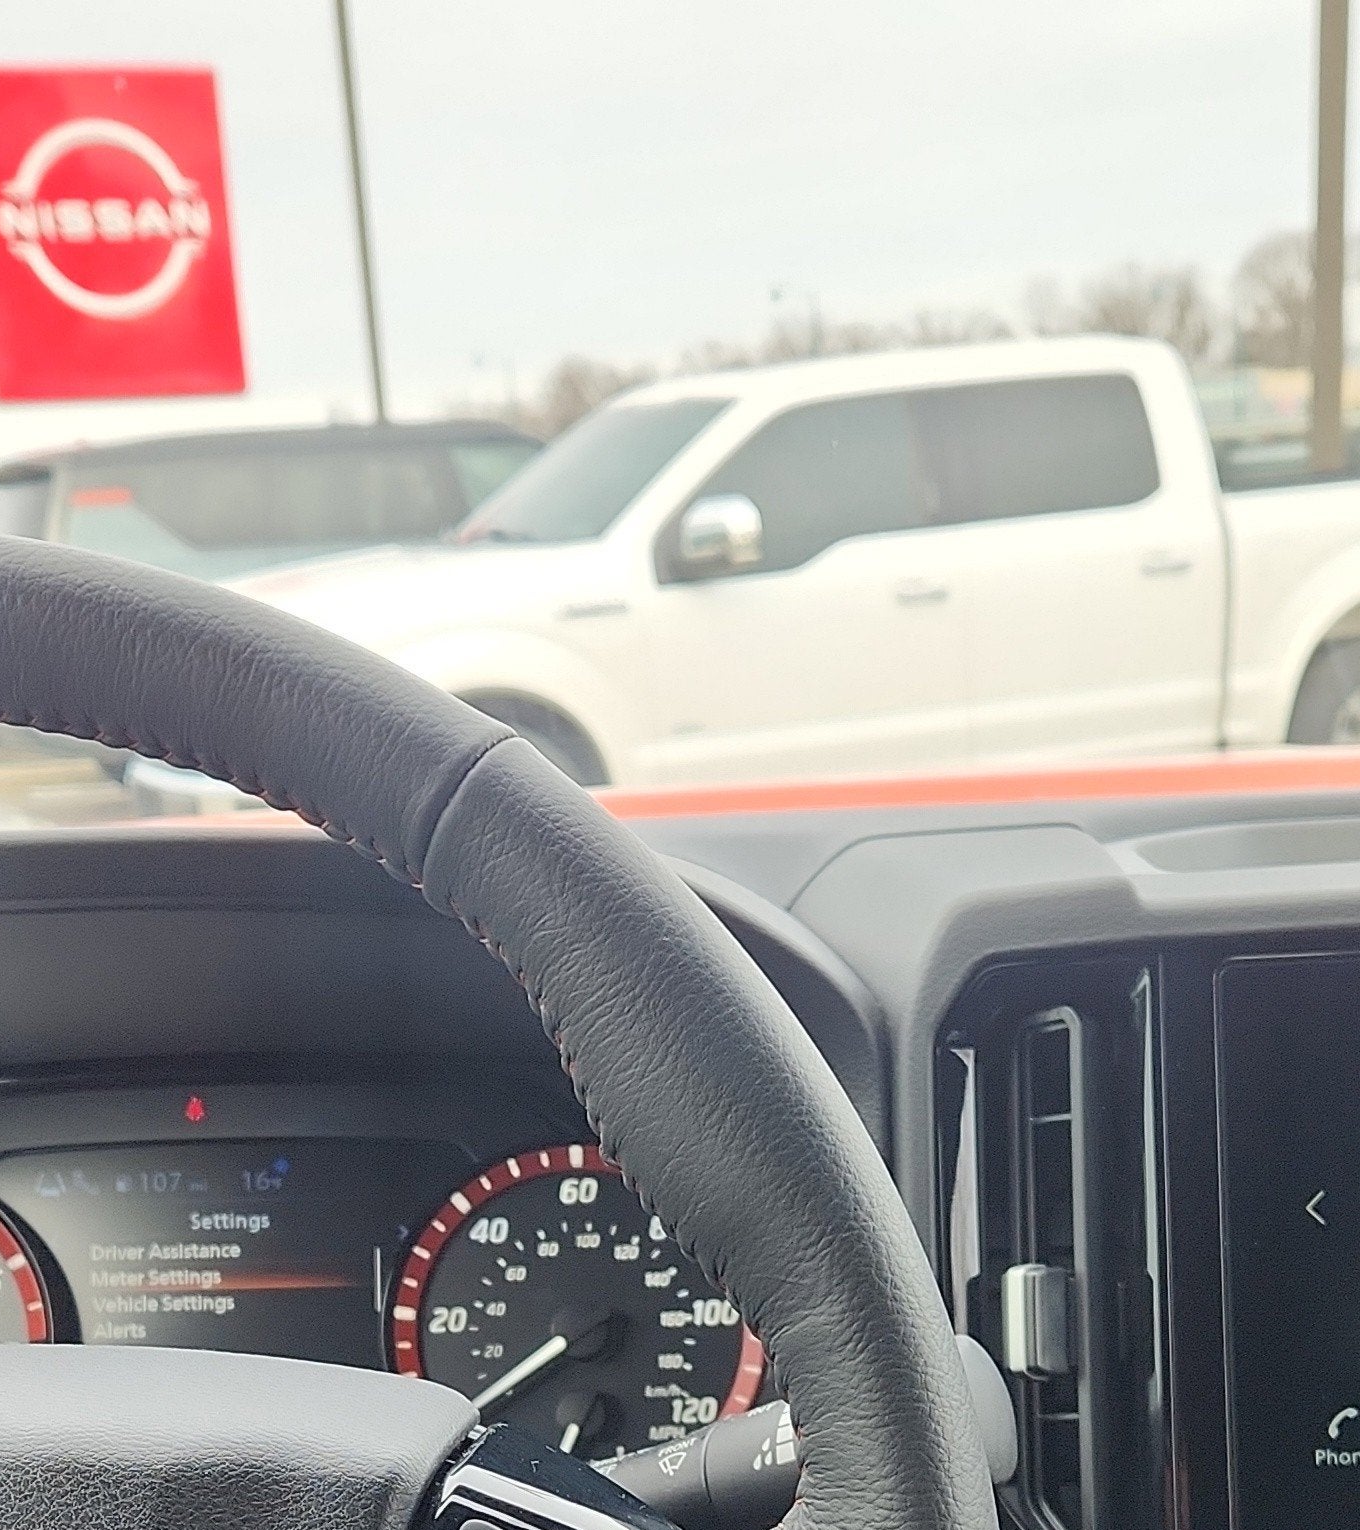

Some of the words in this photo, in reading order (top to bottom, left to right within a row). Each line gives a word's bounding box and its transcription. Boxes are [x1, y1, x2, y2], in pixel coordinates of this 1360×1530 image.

[140, 1171, 183, 1194] 107
[559, 1177, 599, 1205] 60
[190, 1212, 271, 1234] Settings
[468, 1216, 509, 1245] 40
[90, 1244, 145, 1262] Driver
[148, 1243, 242, 1260] Assistance
[90, 1271, 145, 1288] Meter
[148, 1270, 222, 1288] Settings
[93, 1297, 159, 1313] Vehicle
[162, 1295, 235, 1314] Settings
[485, 1301, 507, 1317] 40
[692, 1299, 740, 1327] 100
[428, 1305, 468, 1334] 20
[93, 1323, 147, 1341] Alerts
[483, 1344, 504, 1359] 20
[671, 1396, 719, 1424] 120
